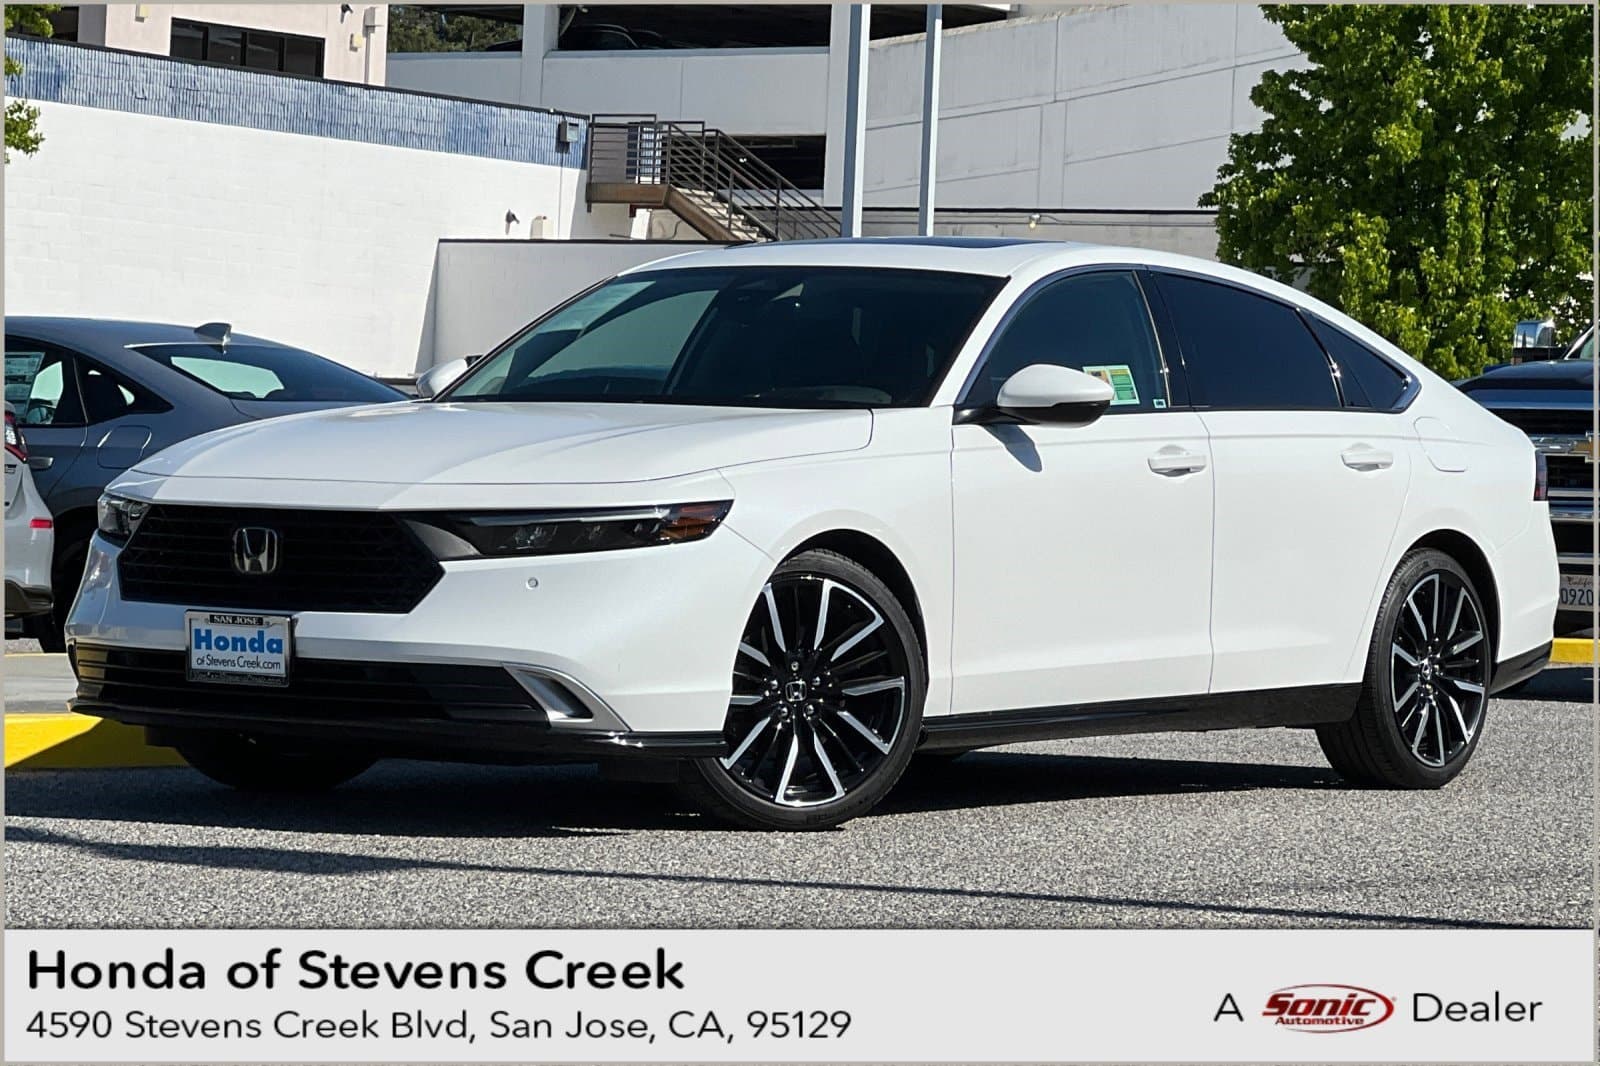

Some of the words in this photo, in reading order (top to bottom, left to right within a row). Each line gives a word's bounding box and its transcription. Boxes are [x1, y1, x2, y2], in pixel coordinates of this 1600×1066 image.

[213, 615, 233, 624] SAN
[235, 616, 261, 625] JOSE
[194, 628, 283, 654] Honda
[196, 655, 205, 666] of
